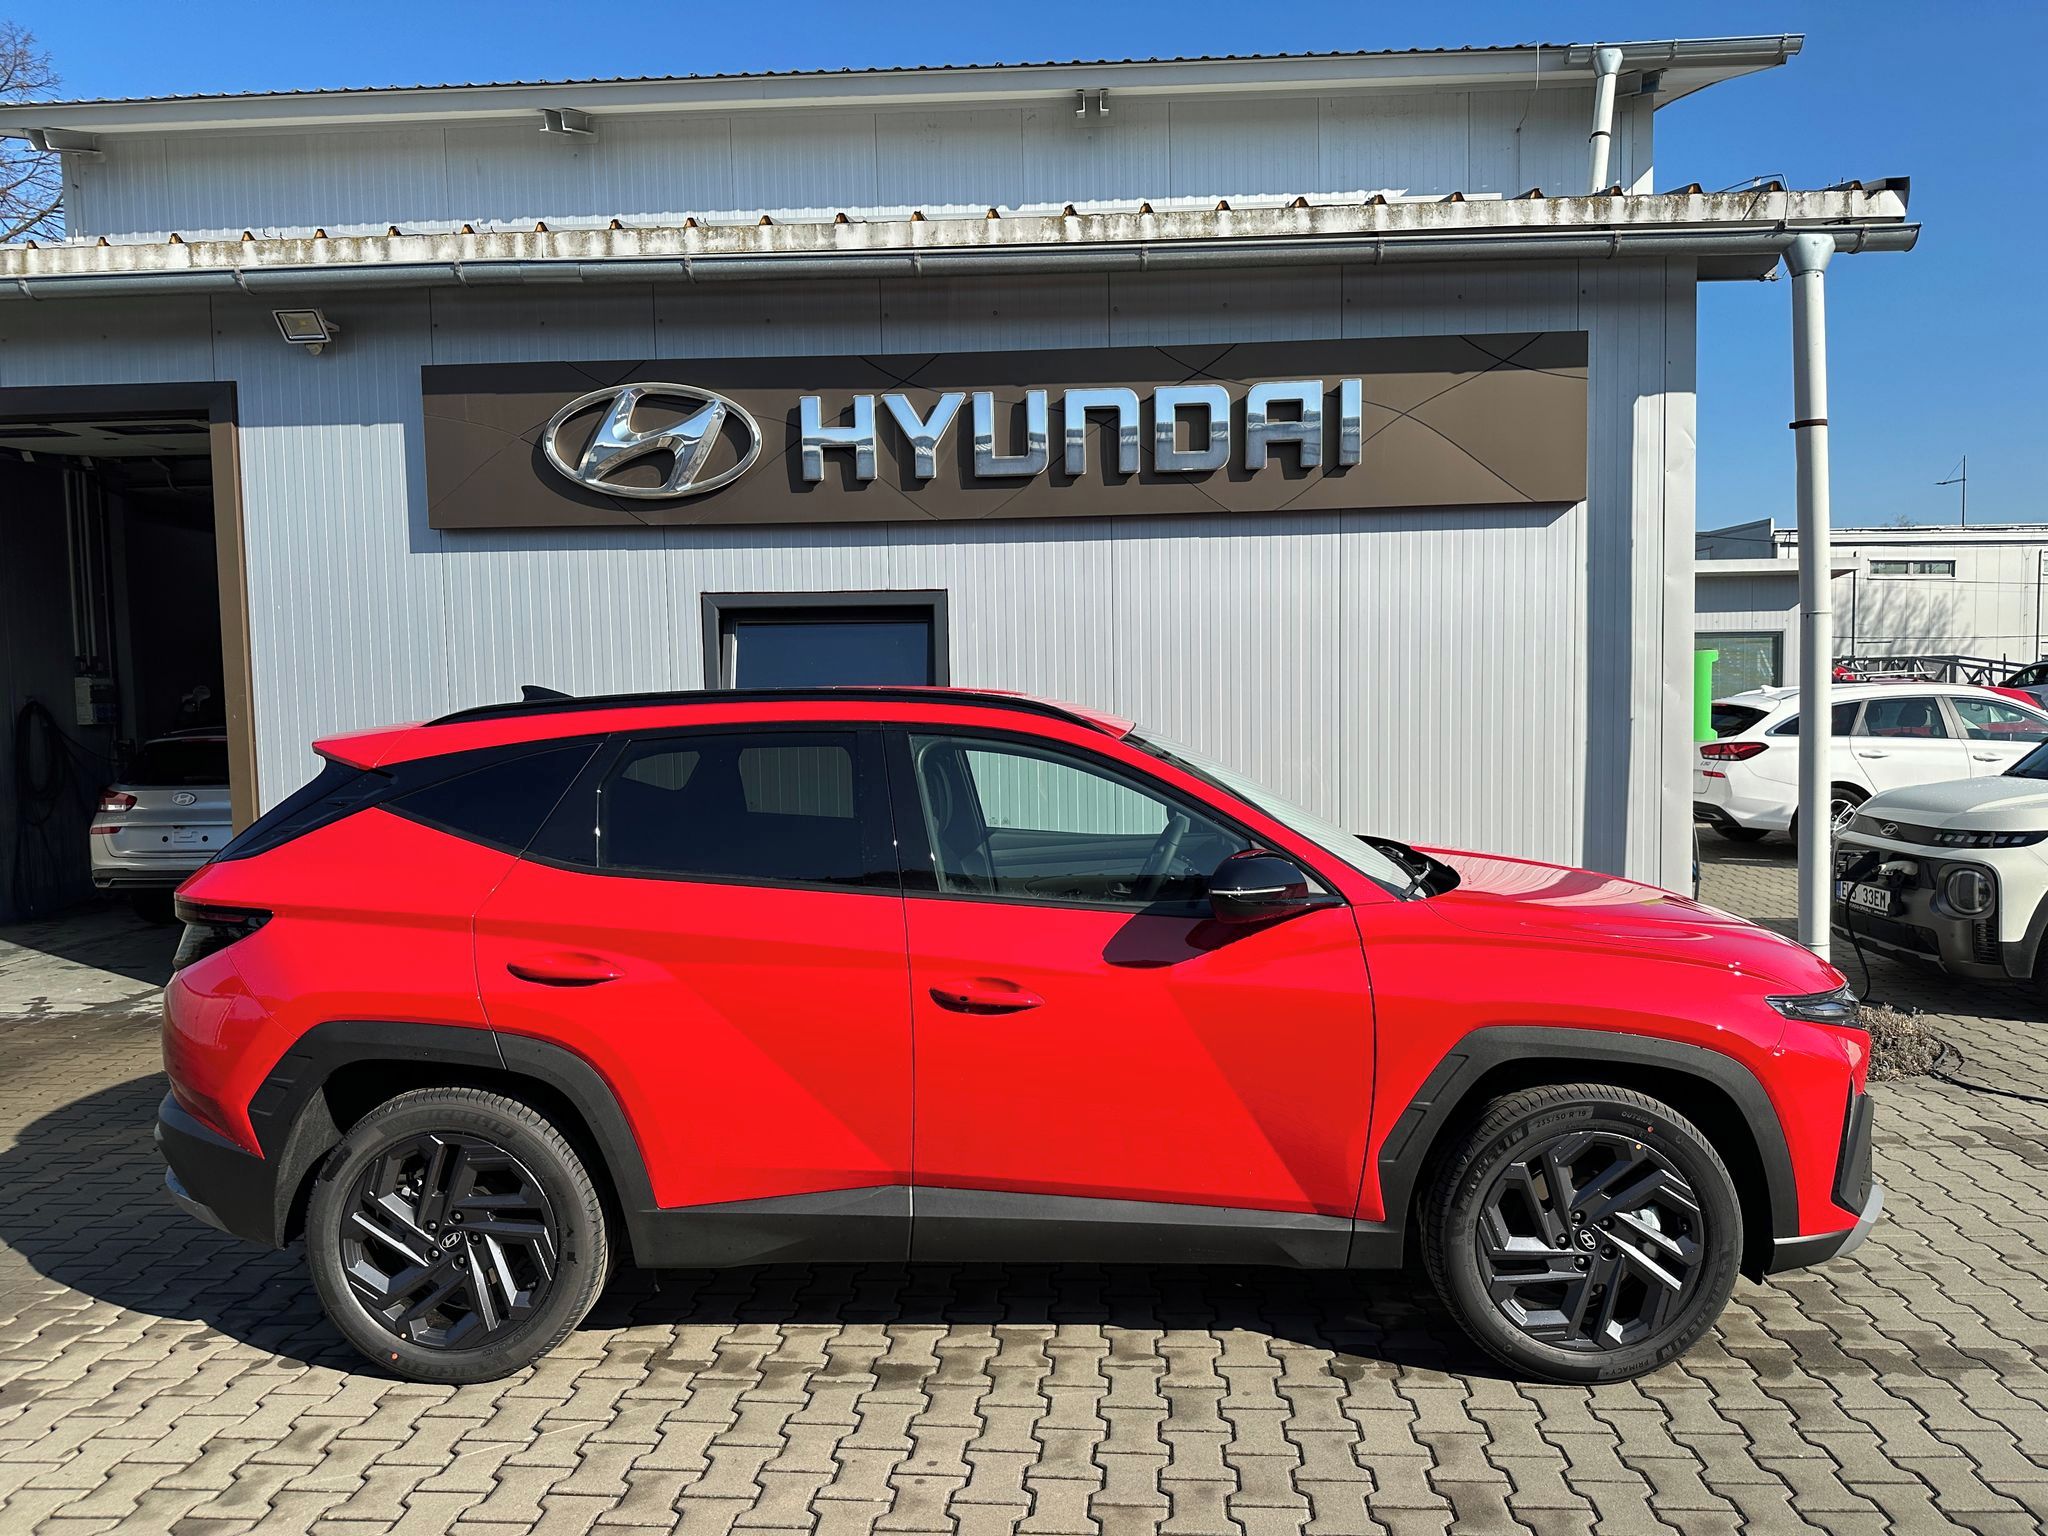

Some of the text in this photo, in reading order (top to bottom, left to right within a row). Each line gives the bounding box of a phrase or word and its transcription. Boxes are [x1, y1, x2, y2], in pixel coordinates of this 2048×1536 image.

[799, 378, 1363, 482] HYUNDAI
[1863, 887, 1886, 909] 33EM
[1536, 1113, 1566, 1128] 235/50
[1611, 1360, 1649, 1375] PRIMACY
